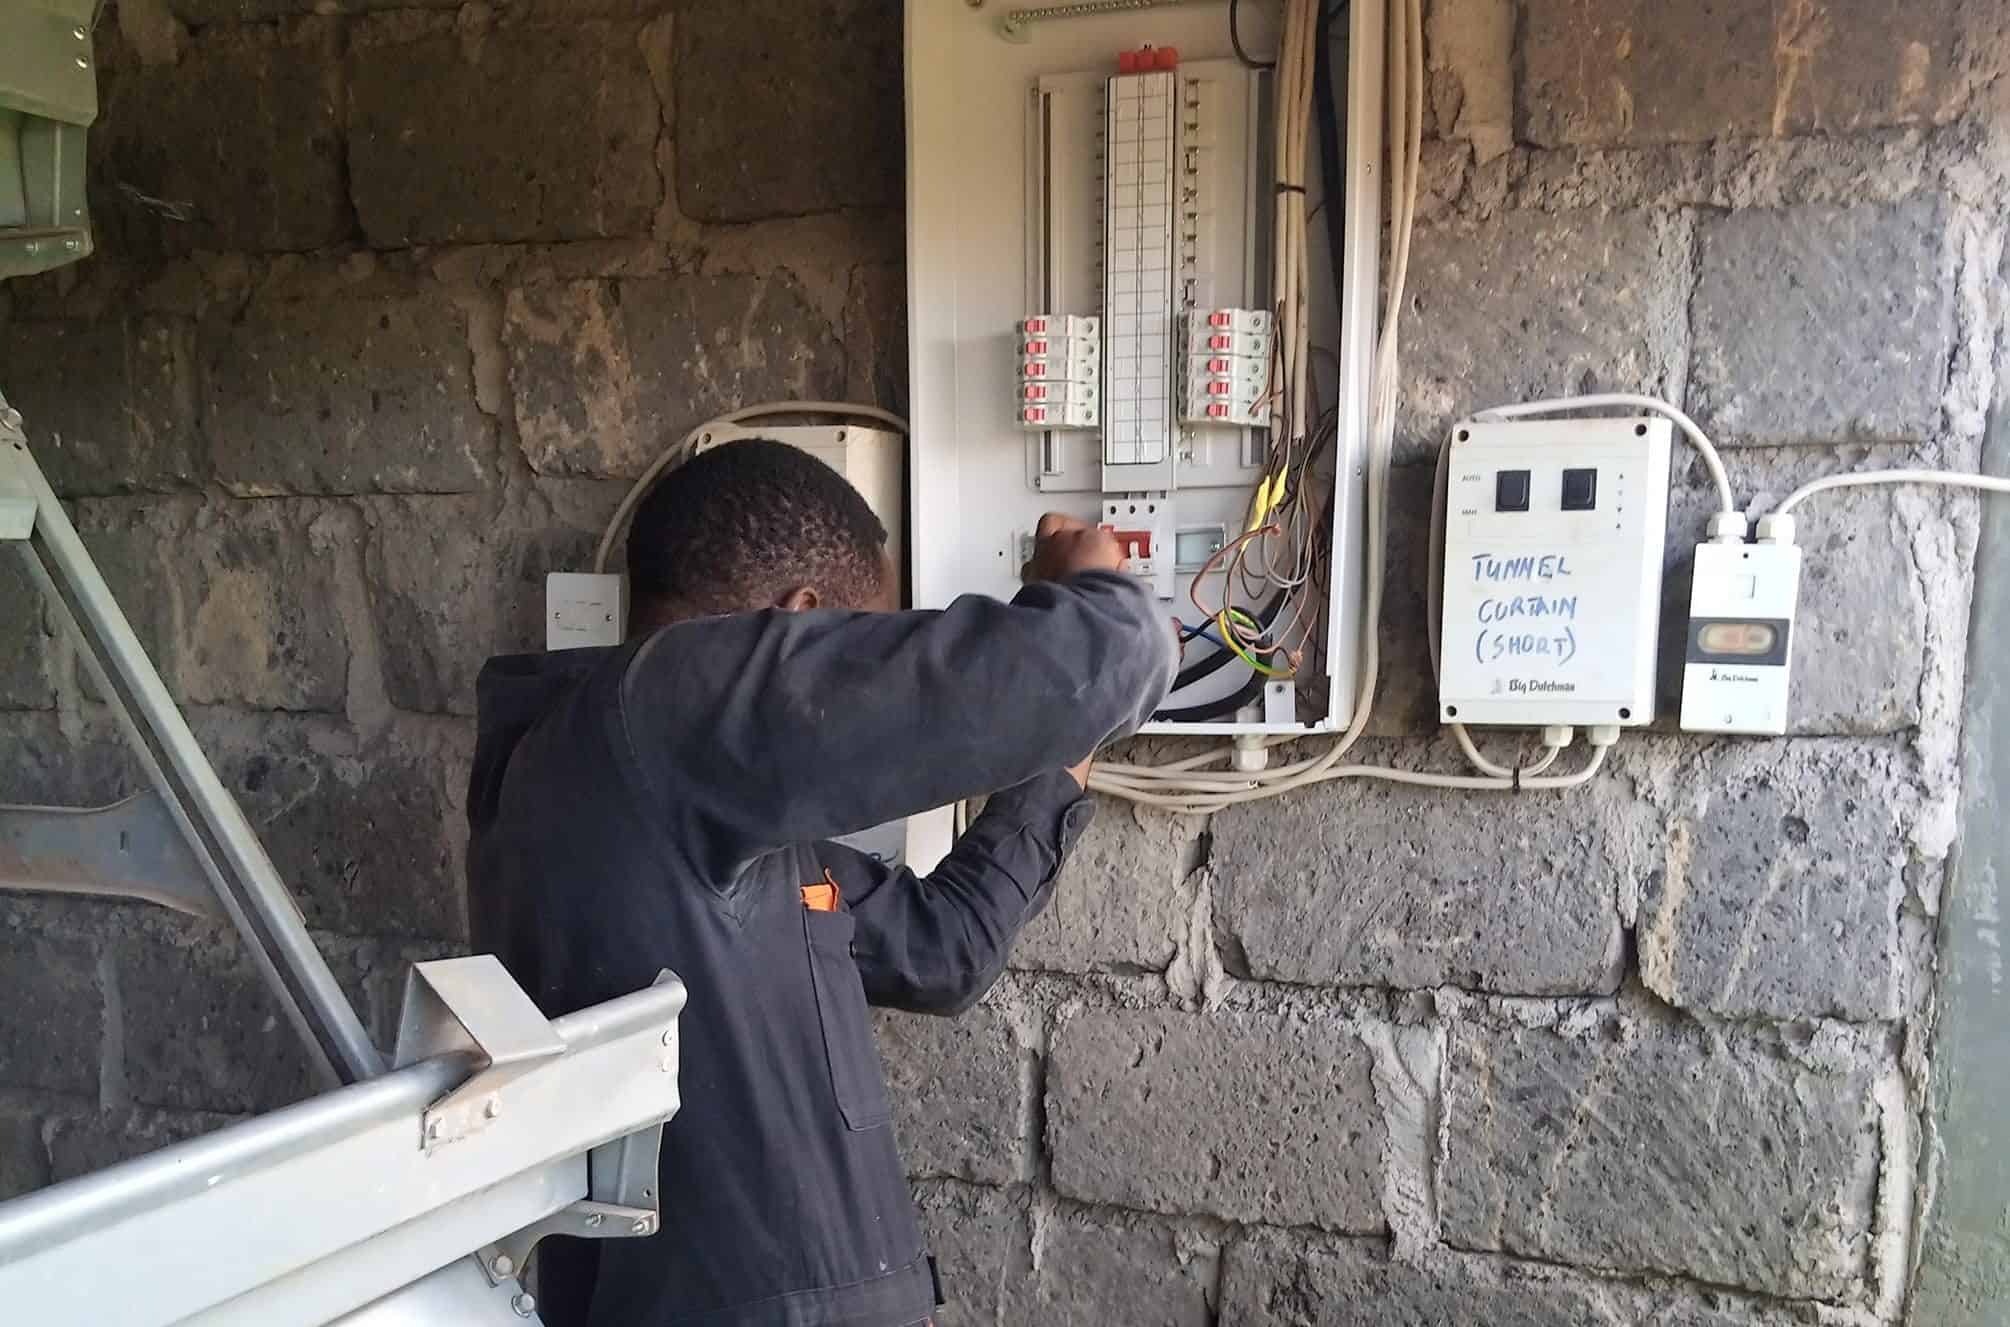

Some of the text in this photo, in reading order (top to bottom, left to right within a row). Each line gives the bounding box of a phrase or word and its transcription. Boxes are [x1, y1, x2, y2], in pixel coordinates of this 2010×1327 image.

[1472, 553, 1571, 581] TUNNEL
[1478, 595, 1577, 623] CURTAIN
[1475, 626, 1577, 666] (SHORT)
[1508, 679, 1576, 694] Big Dutchman
